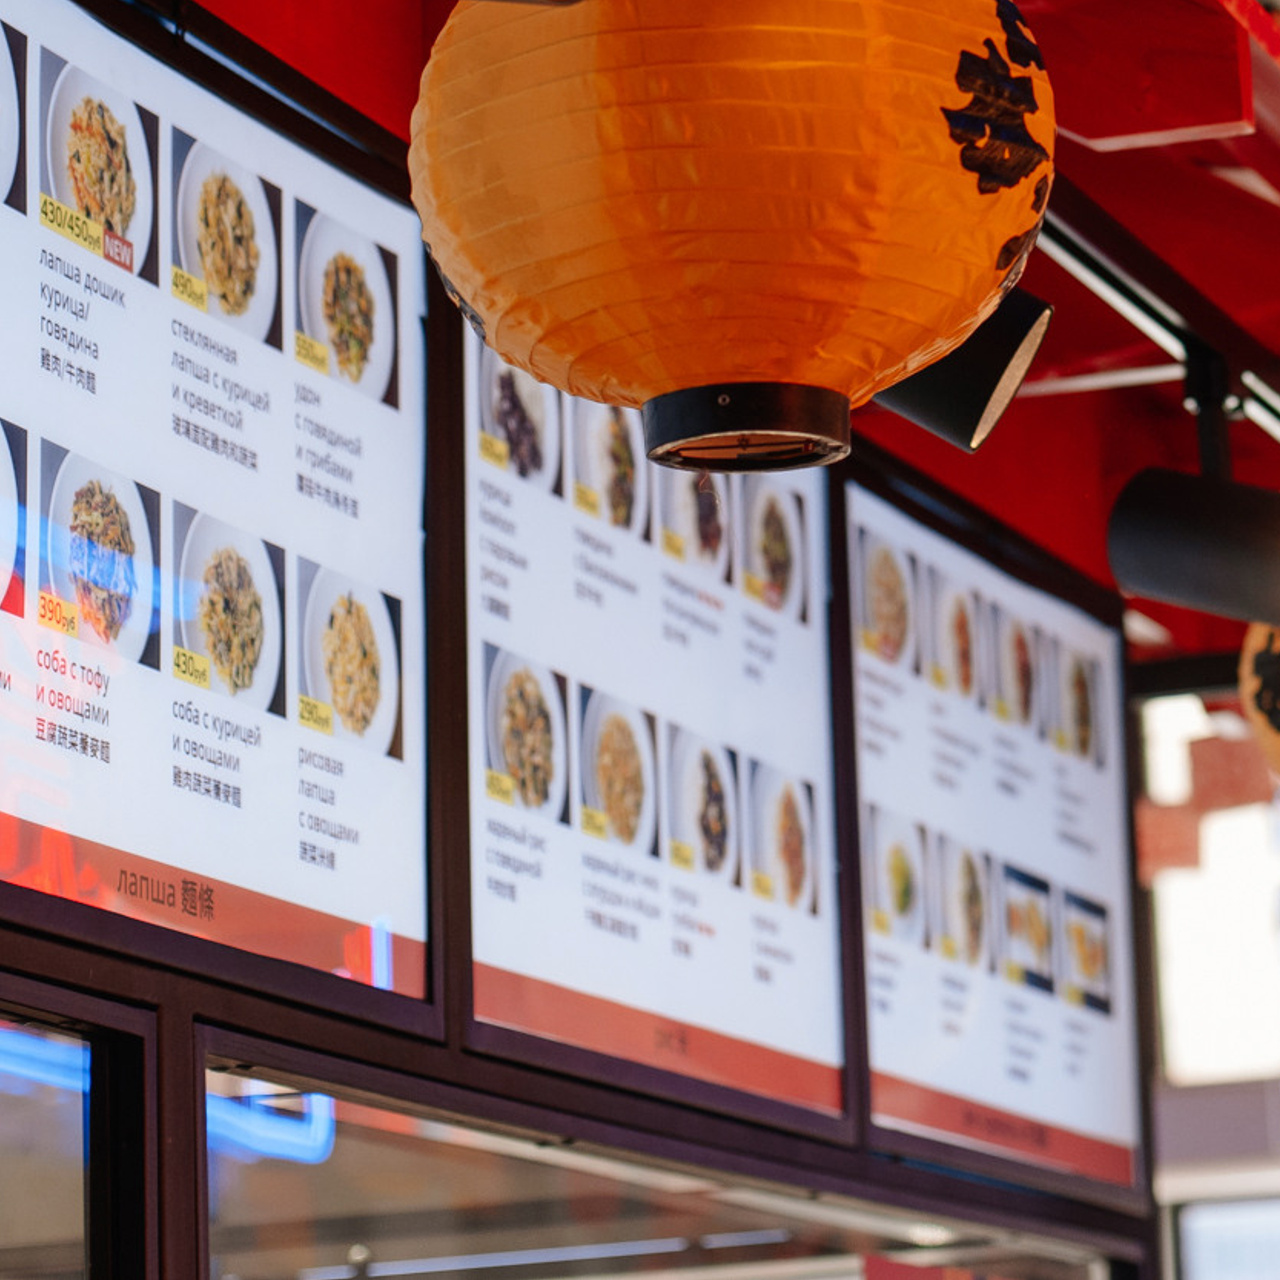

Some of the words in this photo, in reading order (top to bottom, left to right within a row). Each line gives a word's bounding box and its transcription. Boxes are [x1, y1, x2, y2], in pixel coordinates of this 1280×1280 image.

[103, 232, 132, 268] NEW
[39, 249, 82, 284] лапша
[84, 267, 126, 308] дошик
[40, 281, 90, 322] курица/
[40, 315, 99, 360] говядина
[171, 318, 238, 365] стеклянная
[171, 351, 210, 384] лапша
[212, 370, 219, 389] с
[222, 375, 270, 413] курицей
[172, 383, 180, 400] и
[183, 388, 244, 432] креветкой
[37, 649, 67, 676] соба
[70, 662, 76, 680] с
[80, 665, 110, 698] тофу
[36, 683, 45, 704] и
[48, 689, 109, 727] овощами
[172, 700, 200, 726] соба
[202, 712, 209, 730] с
[212, 715, 262, 748] курицей
[172, 734, 180, 752] и
[183, 739, 241, 773] овощами
[298, 748, 344, 776] рисовая
[298, 779, 336, 806] лапша
[307, 814, 360, 846] овощами
[117, 868, 176, 908] лапша
